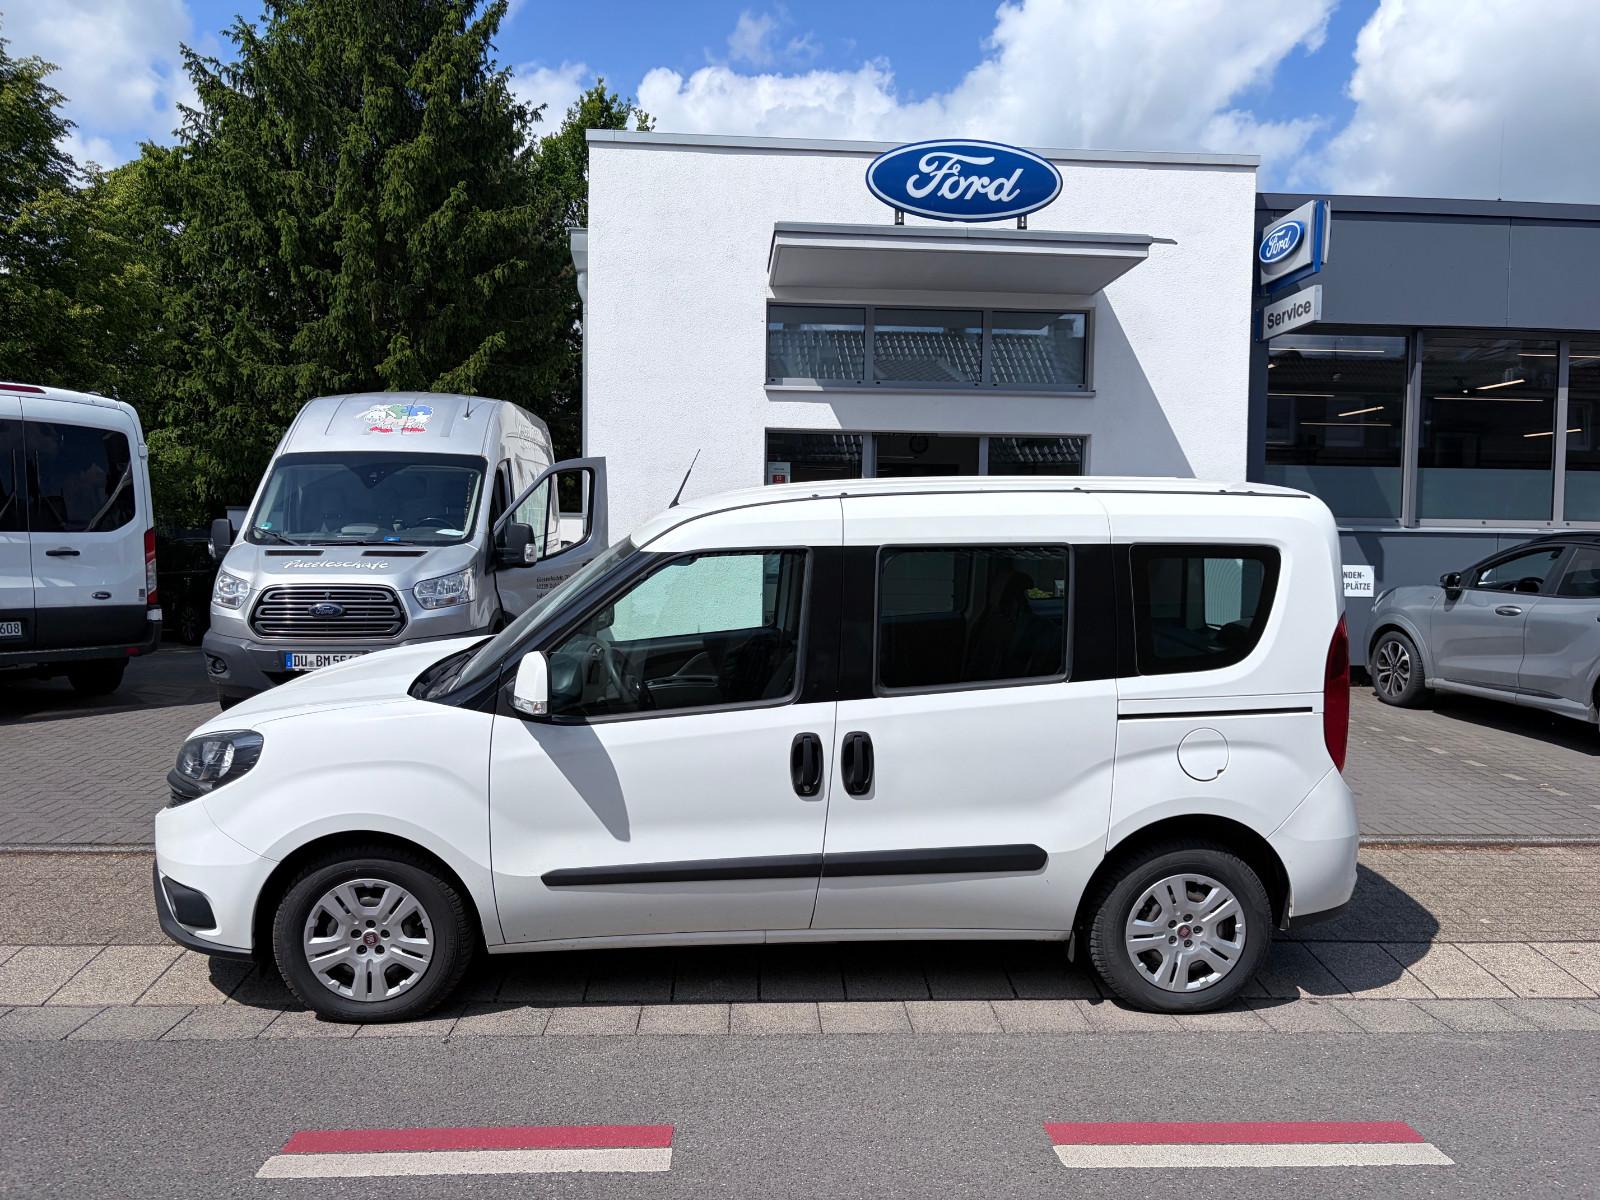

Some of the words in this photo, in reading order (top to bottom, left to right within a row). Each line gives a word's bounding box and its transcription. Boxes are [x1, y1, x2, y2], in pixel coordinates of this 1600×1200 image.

[906, 151, 1024, 202] Ford
[1266, 229, 1292, 258] Ford
[1267, 301, 1312, 330] Service
[1343, 581, 1371, 590] PLÄTZE
[293, 655, 308, 667] DU
[316, 655, 331, 667] BM
